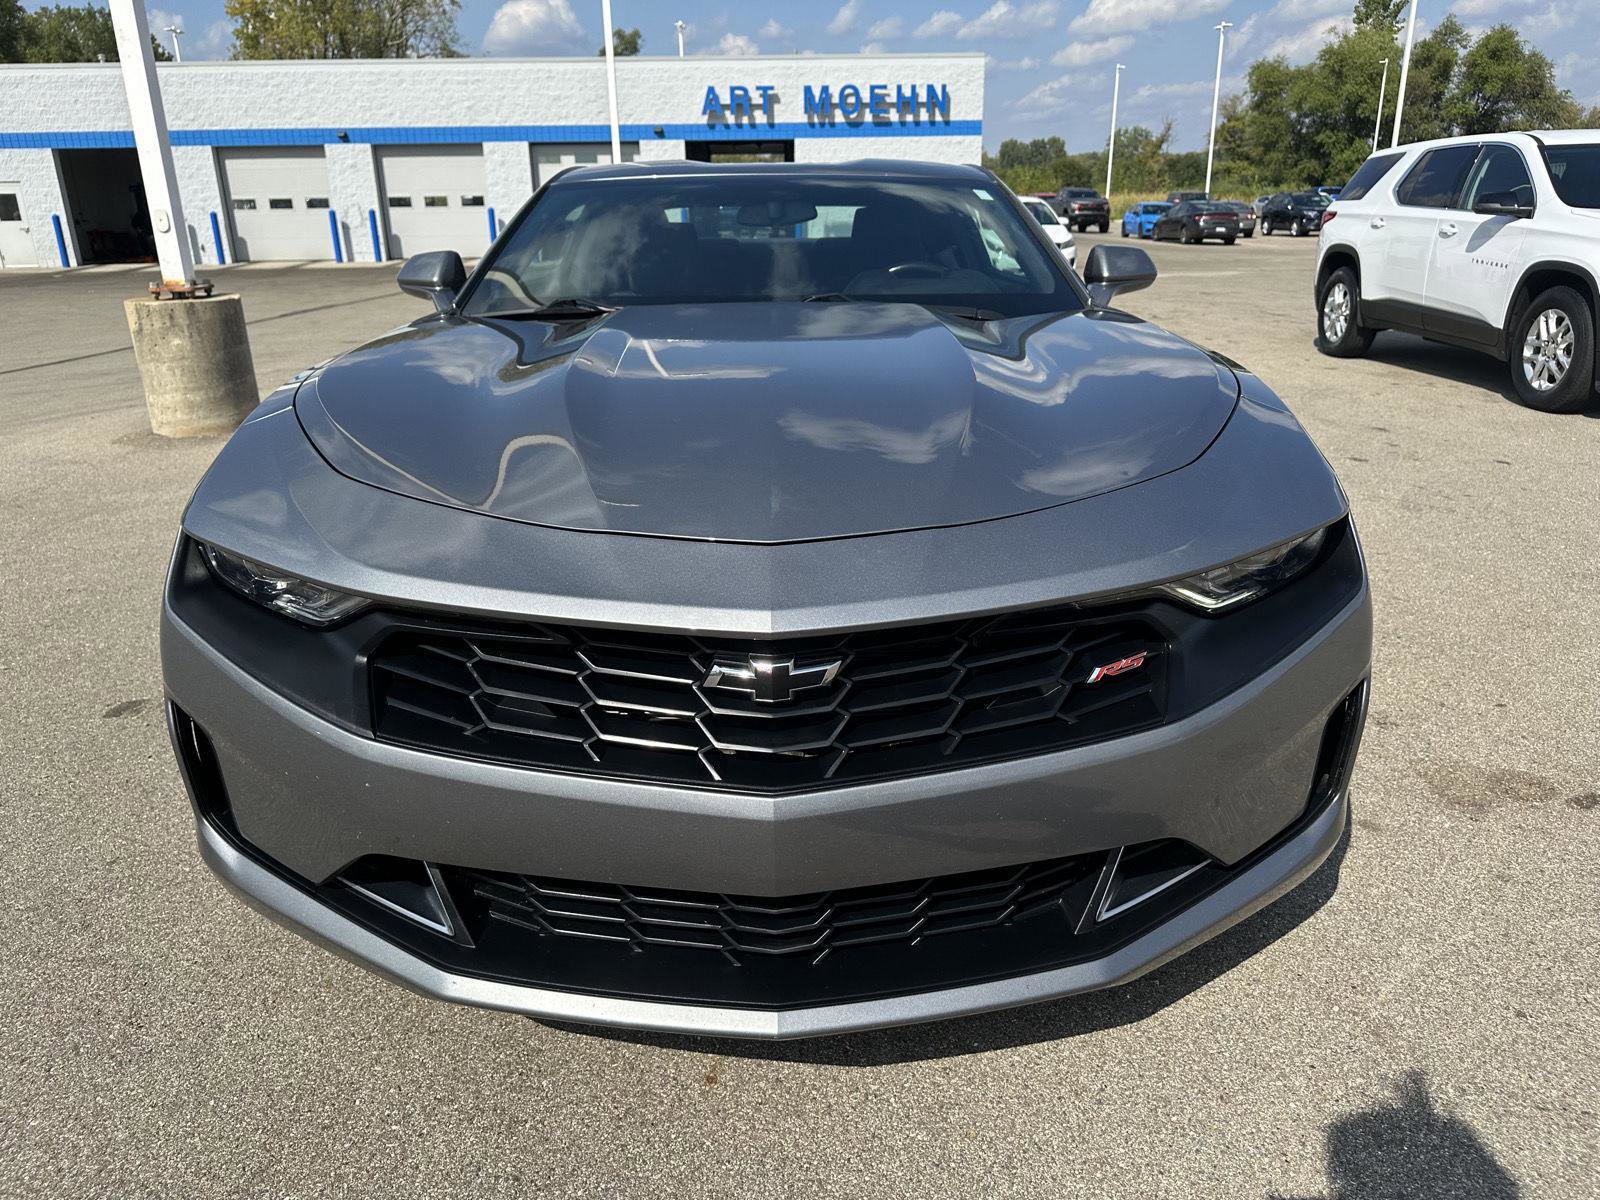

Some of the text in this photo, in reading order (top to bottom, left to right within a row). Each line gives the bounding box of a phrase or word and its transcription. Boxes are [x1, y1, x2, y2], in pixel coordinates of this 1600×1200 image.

[702, 84, 948, 116] ART MOEHN
[1471, 257, 1508, 269] TRAVERSE
[1091, 651, 1148, 682] RS
